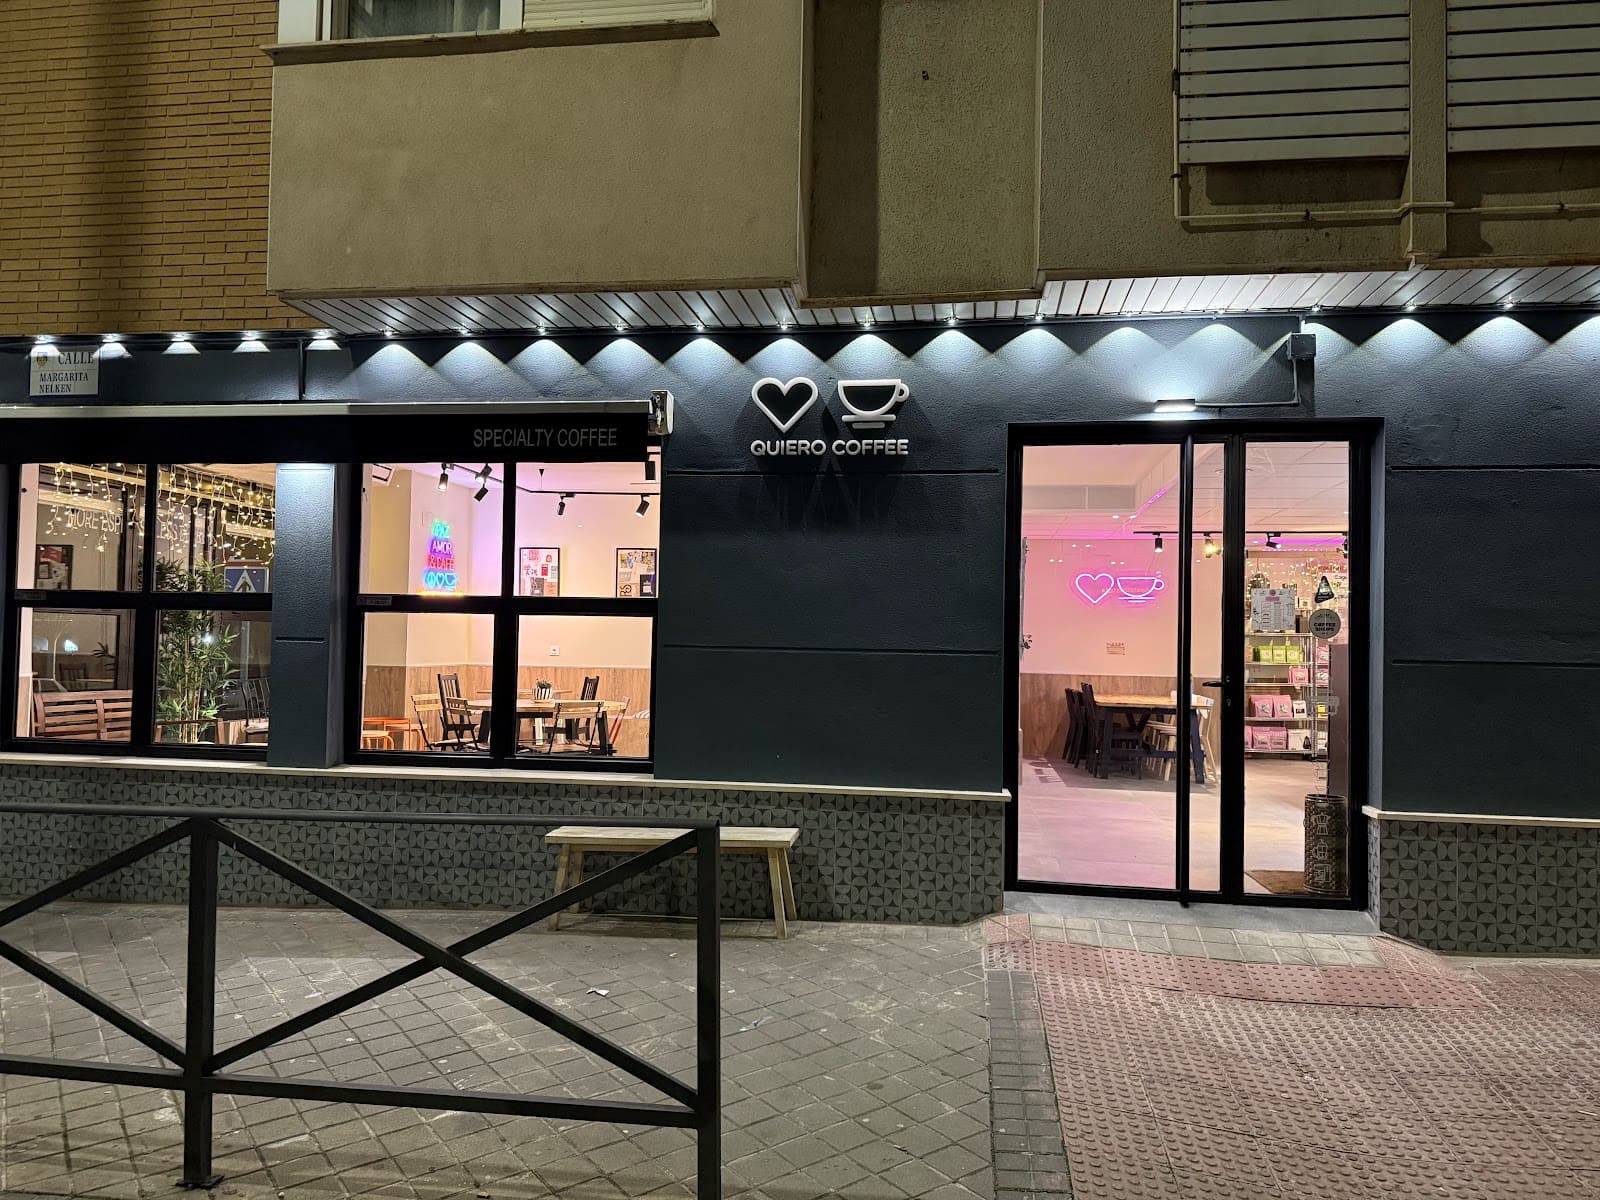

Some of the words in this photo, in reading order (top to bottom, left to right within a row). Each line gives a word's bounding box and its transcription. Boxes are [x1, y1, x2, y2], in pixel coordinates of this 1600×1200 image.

[58, 351, 94, 365] CALLE
[40, 372, 89, 382] MARGARITA
[39, 384, 72, 393] NELKEN
[473, 428, 555, 448] SPECIALTY
[557, 428, 618, 447] COFFEE
[750, 439, 827, 456] QUIERO
[831, 439, 909, 456] COFFEE
[67, 509, 99, 530] MORE
[434, 523, 450, 539] PAZ
[430, 555, 437, 569] &
